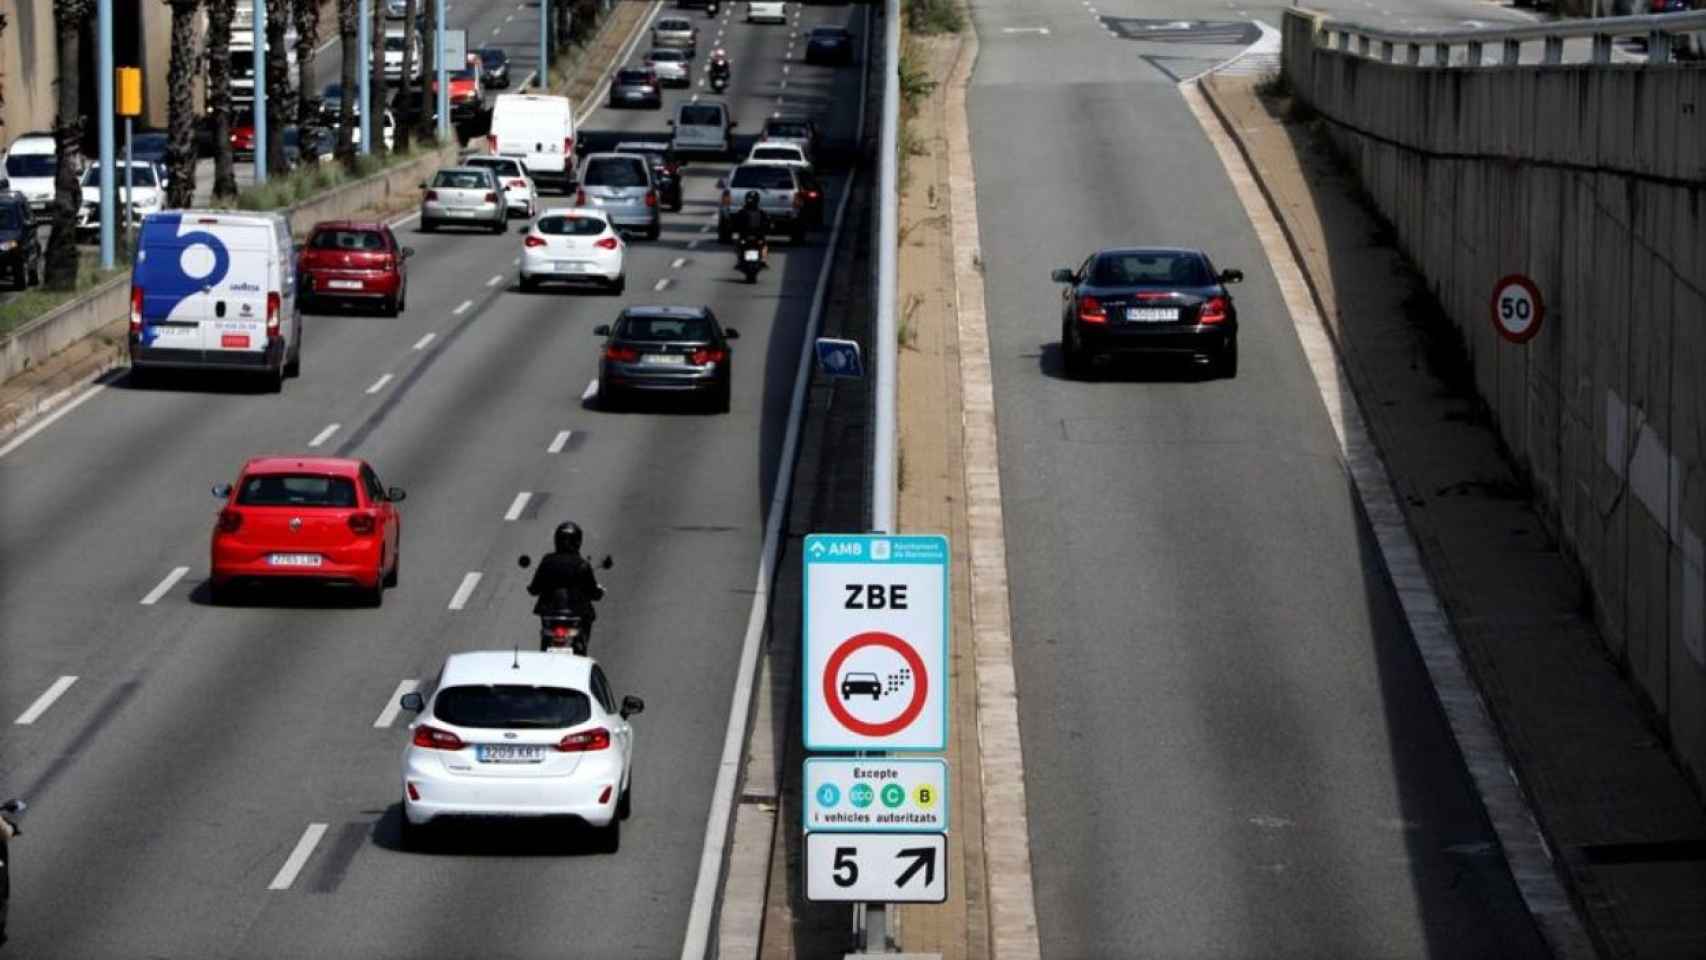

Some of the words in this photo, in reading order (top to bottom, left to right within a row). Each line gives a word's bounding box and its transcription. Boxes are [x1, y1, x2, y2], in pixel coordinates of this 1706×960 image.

[1501, 298, 1531, 320] 50
[828, 542, 862, 556] AMB
[844, 584, 908, 610] ZBE
[853, 768, 899, 780] Excepte
[886, 789, 900, 803] C
[919, 789, 930, 803] B
[824, 812, 871, 823] vehicles
[876, 812, 937, 823] autoritzats
[832, 847, 859, 888] 5
